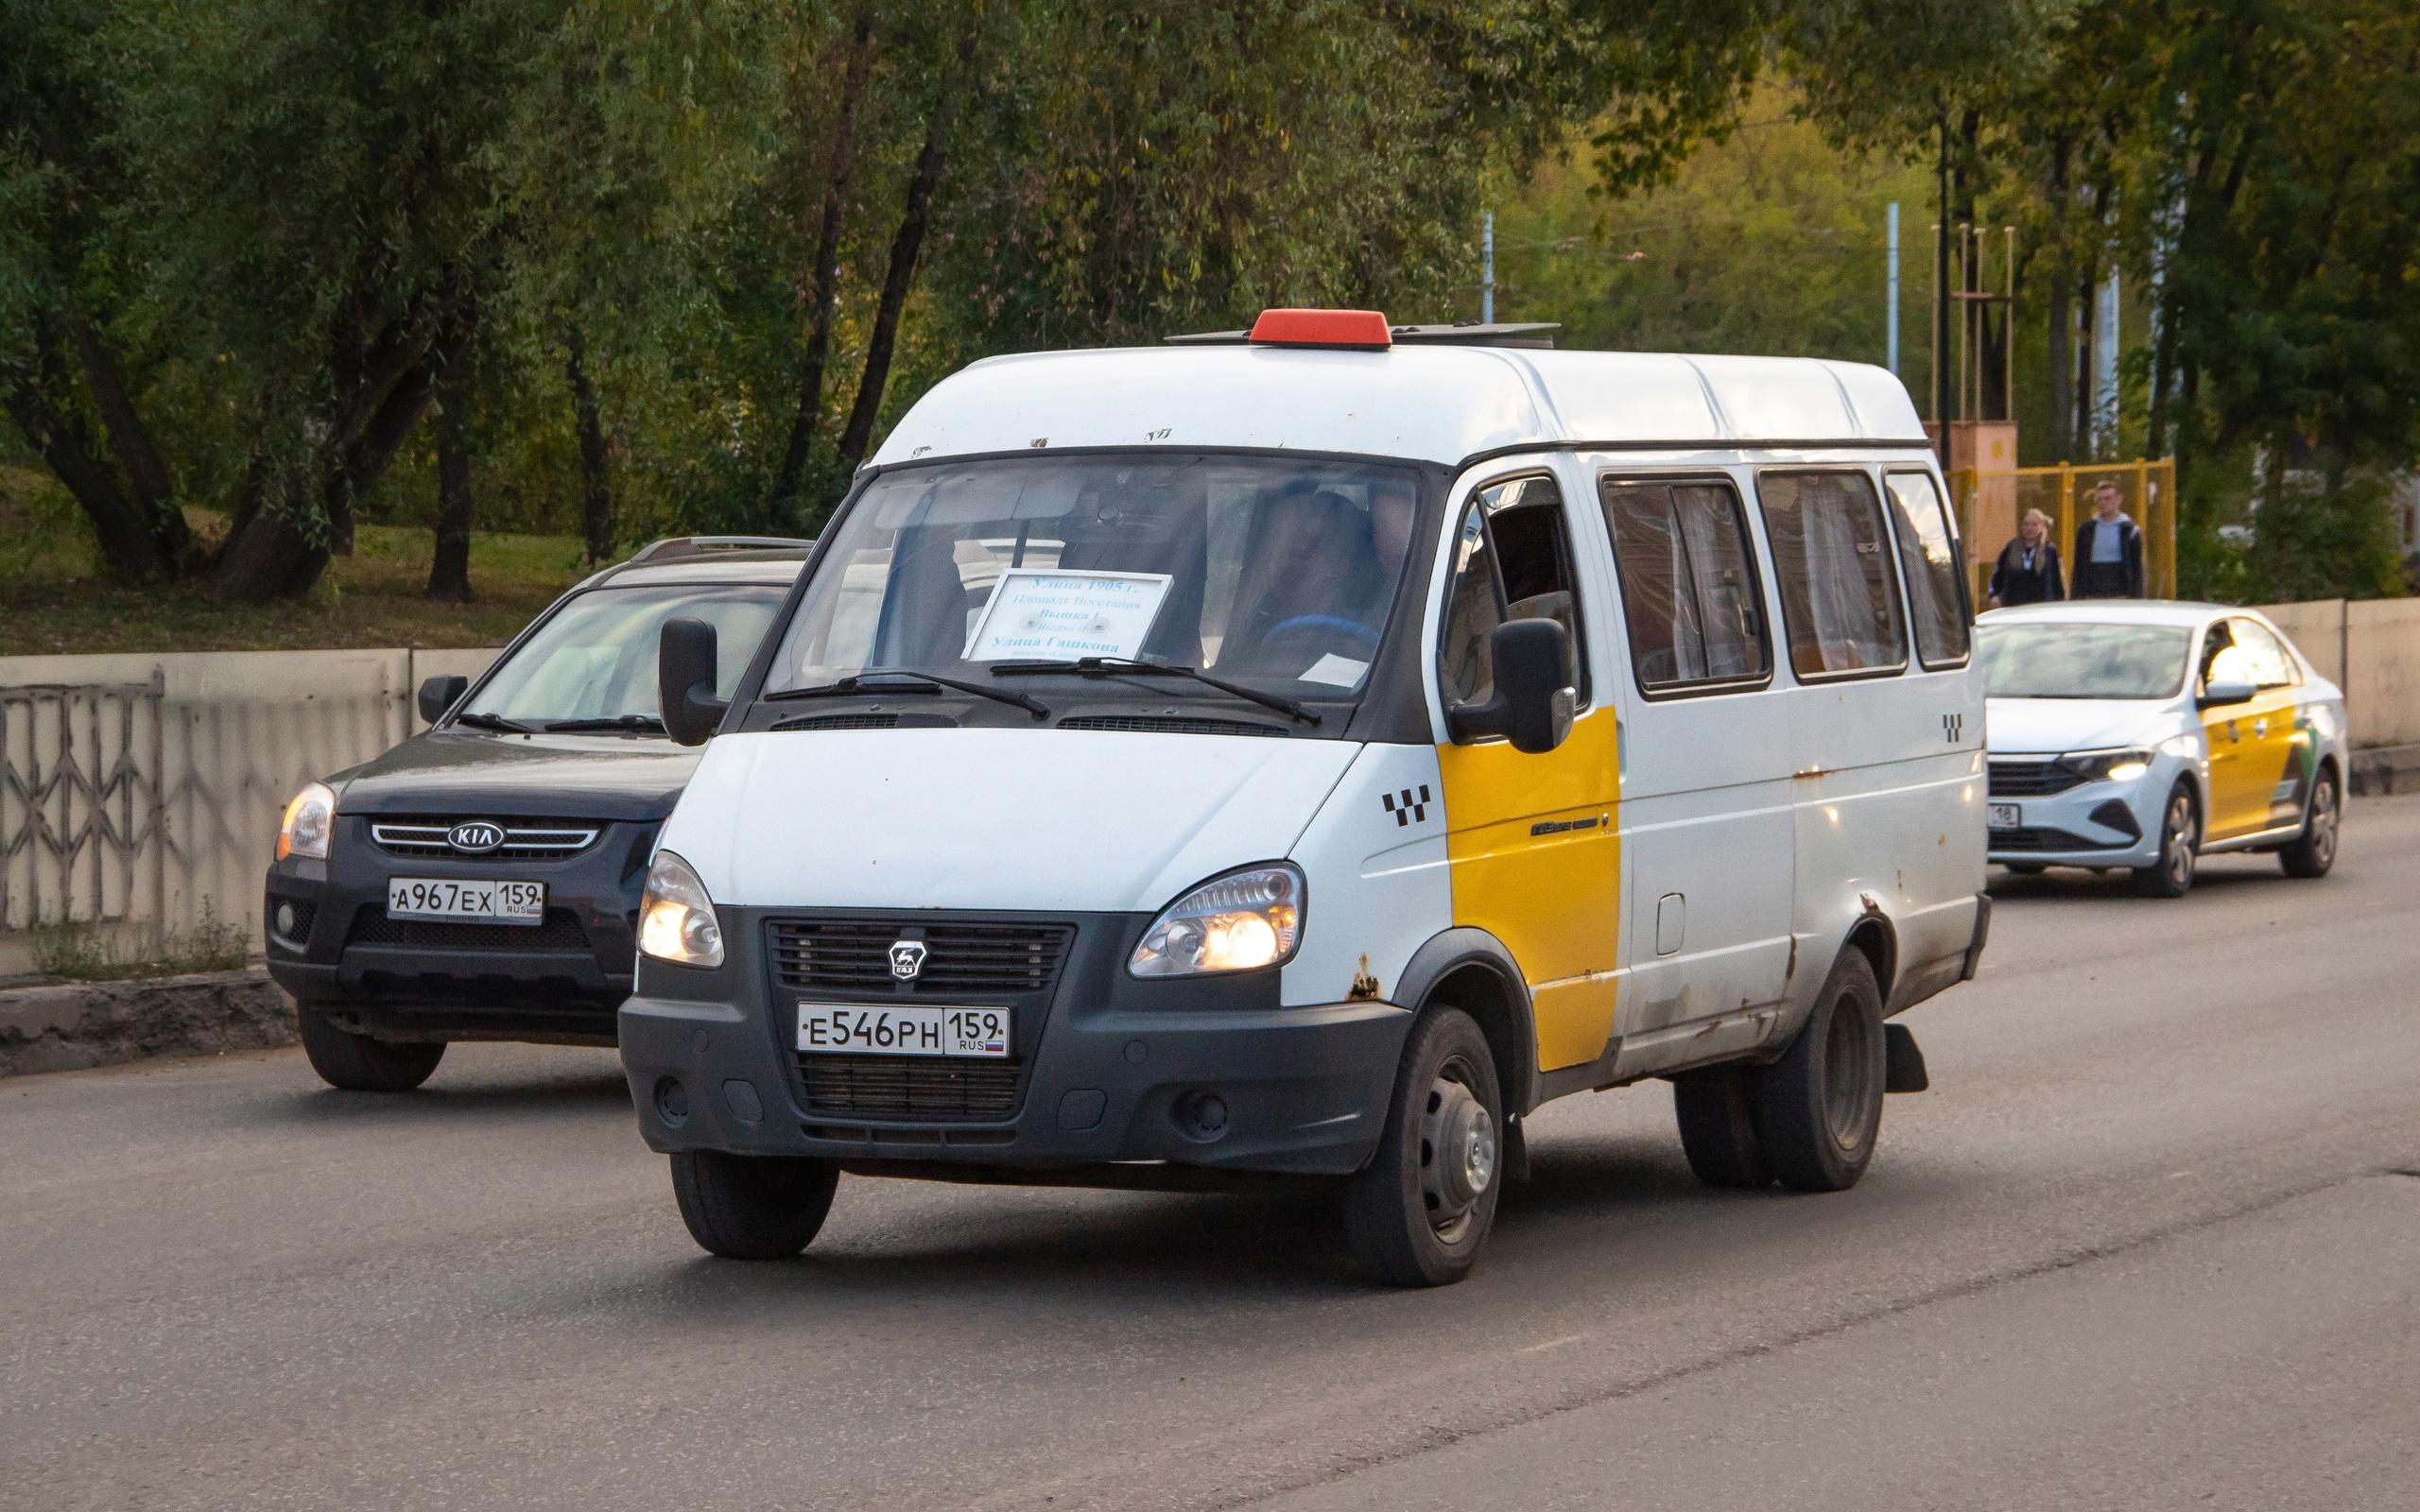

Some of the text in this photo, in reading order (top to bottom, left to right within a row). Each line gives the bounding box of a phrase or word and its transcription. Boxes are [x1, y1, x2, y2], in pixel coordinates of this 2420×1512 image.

[1088, 580, 1124, 592] 1905
[1046, 636, 1120, 654] Гашкова
[457, 828, 493, 846] KIA
[395, 883, 538, 913] А967ЕХ 159
[507, 904, 527, 914] RUS
[809, 1010, 999, 1049] Е546РН 159
[959, 1040, 984, 1051] RUS
